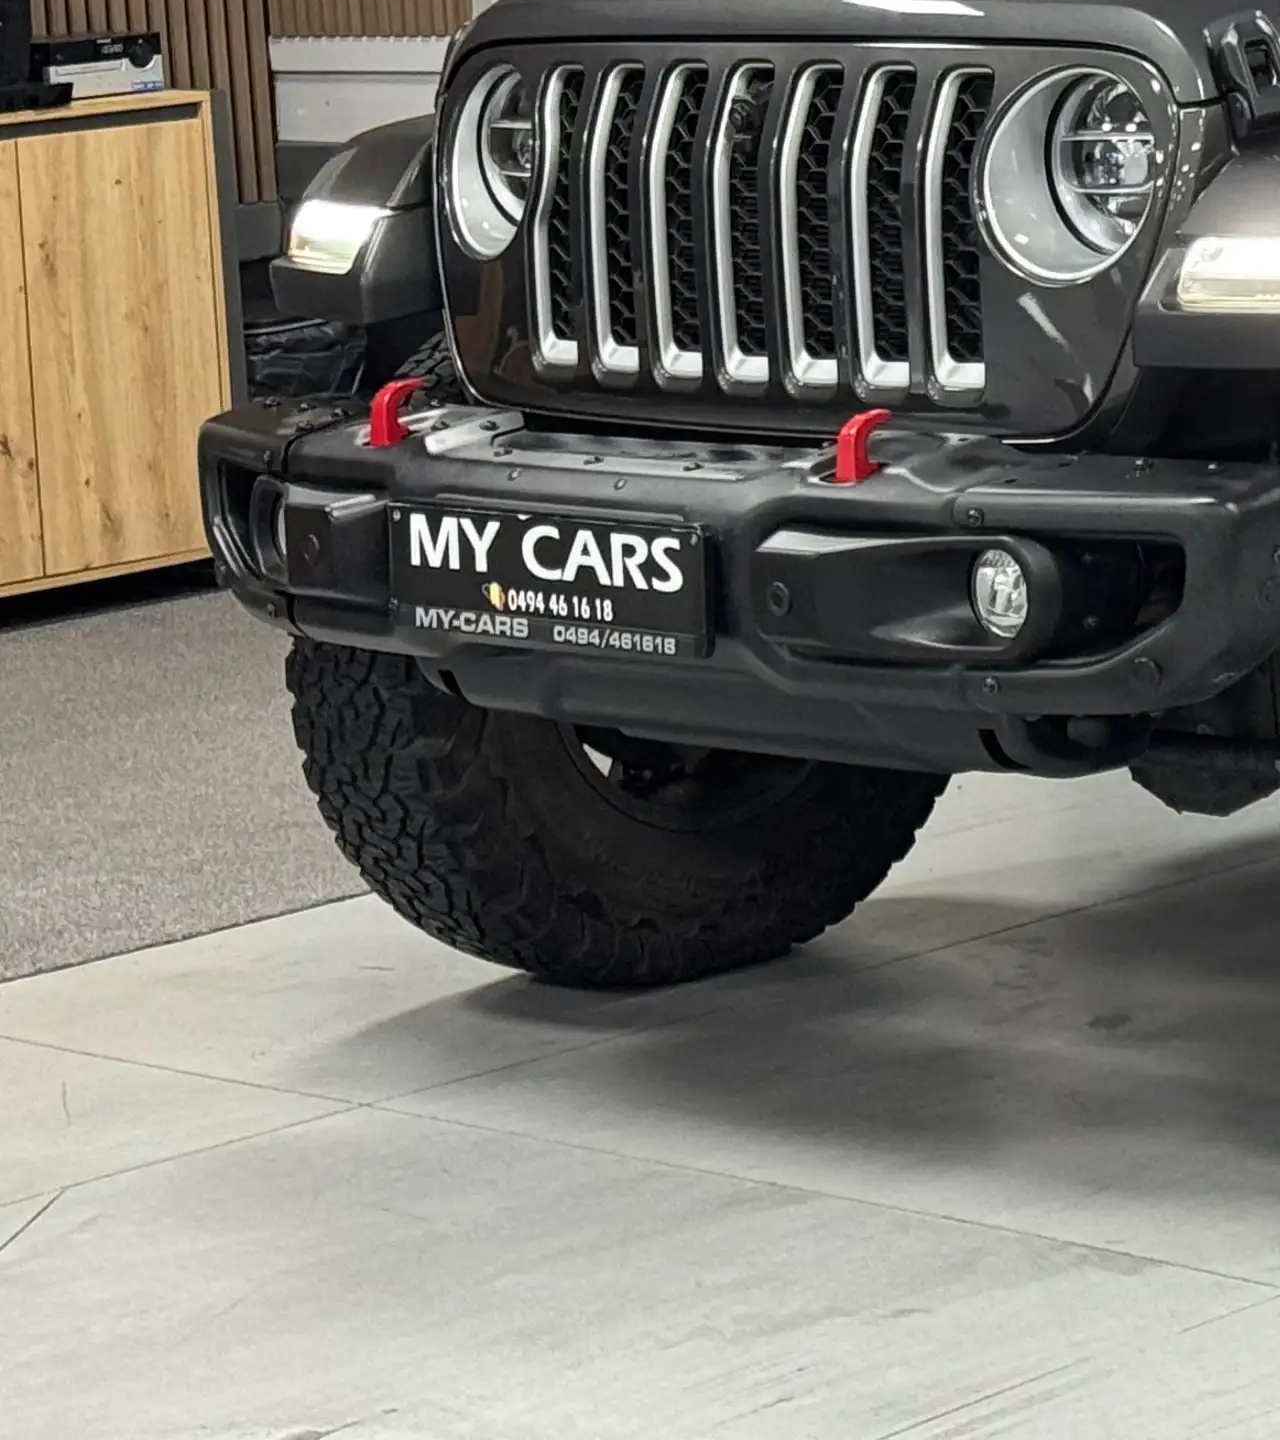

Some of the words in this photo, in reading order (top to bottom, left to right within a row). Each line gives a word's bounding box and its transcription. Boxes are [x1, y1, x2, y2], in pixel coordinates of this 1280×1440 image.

[410, 513, 500, 573] MY
[522, 525, 684, 593] CARS
[507, 588, 545, 614] 0494
[549, 593, 568, 617] 46
[572, 595, 590, 619] 16
[595, 597, 613, 622] 18
[415, 607, 528, 638] MY-CARS
[553, 625, 676, 655] 0494/461618
